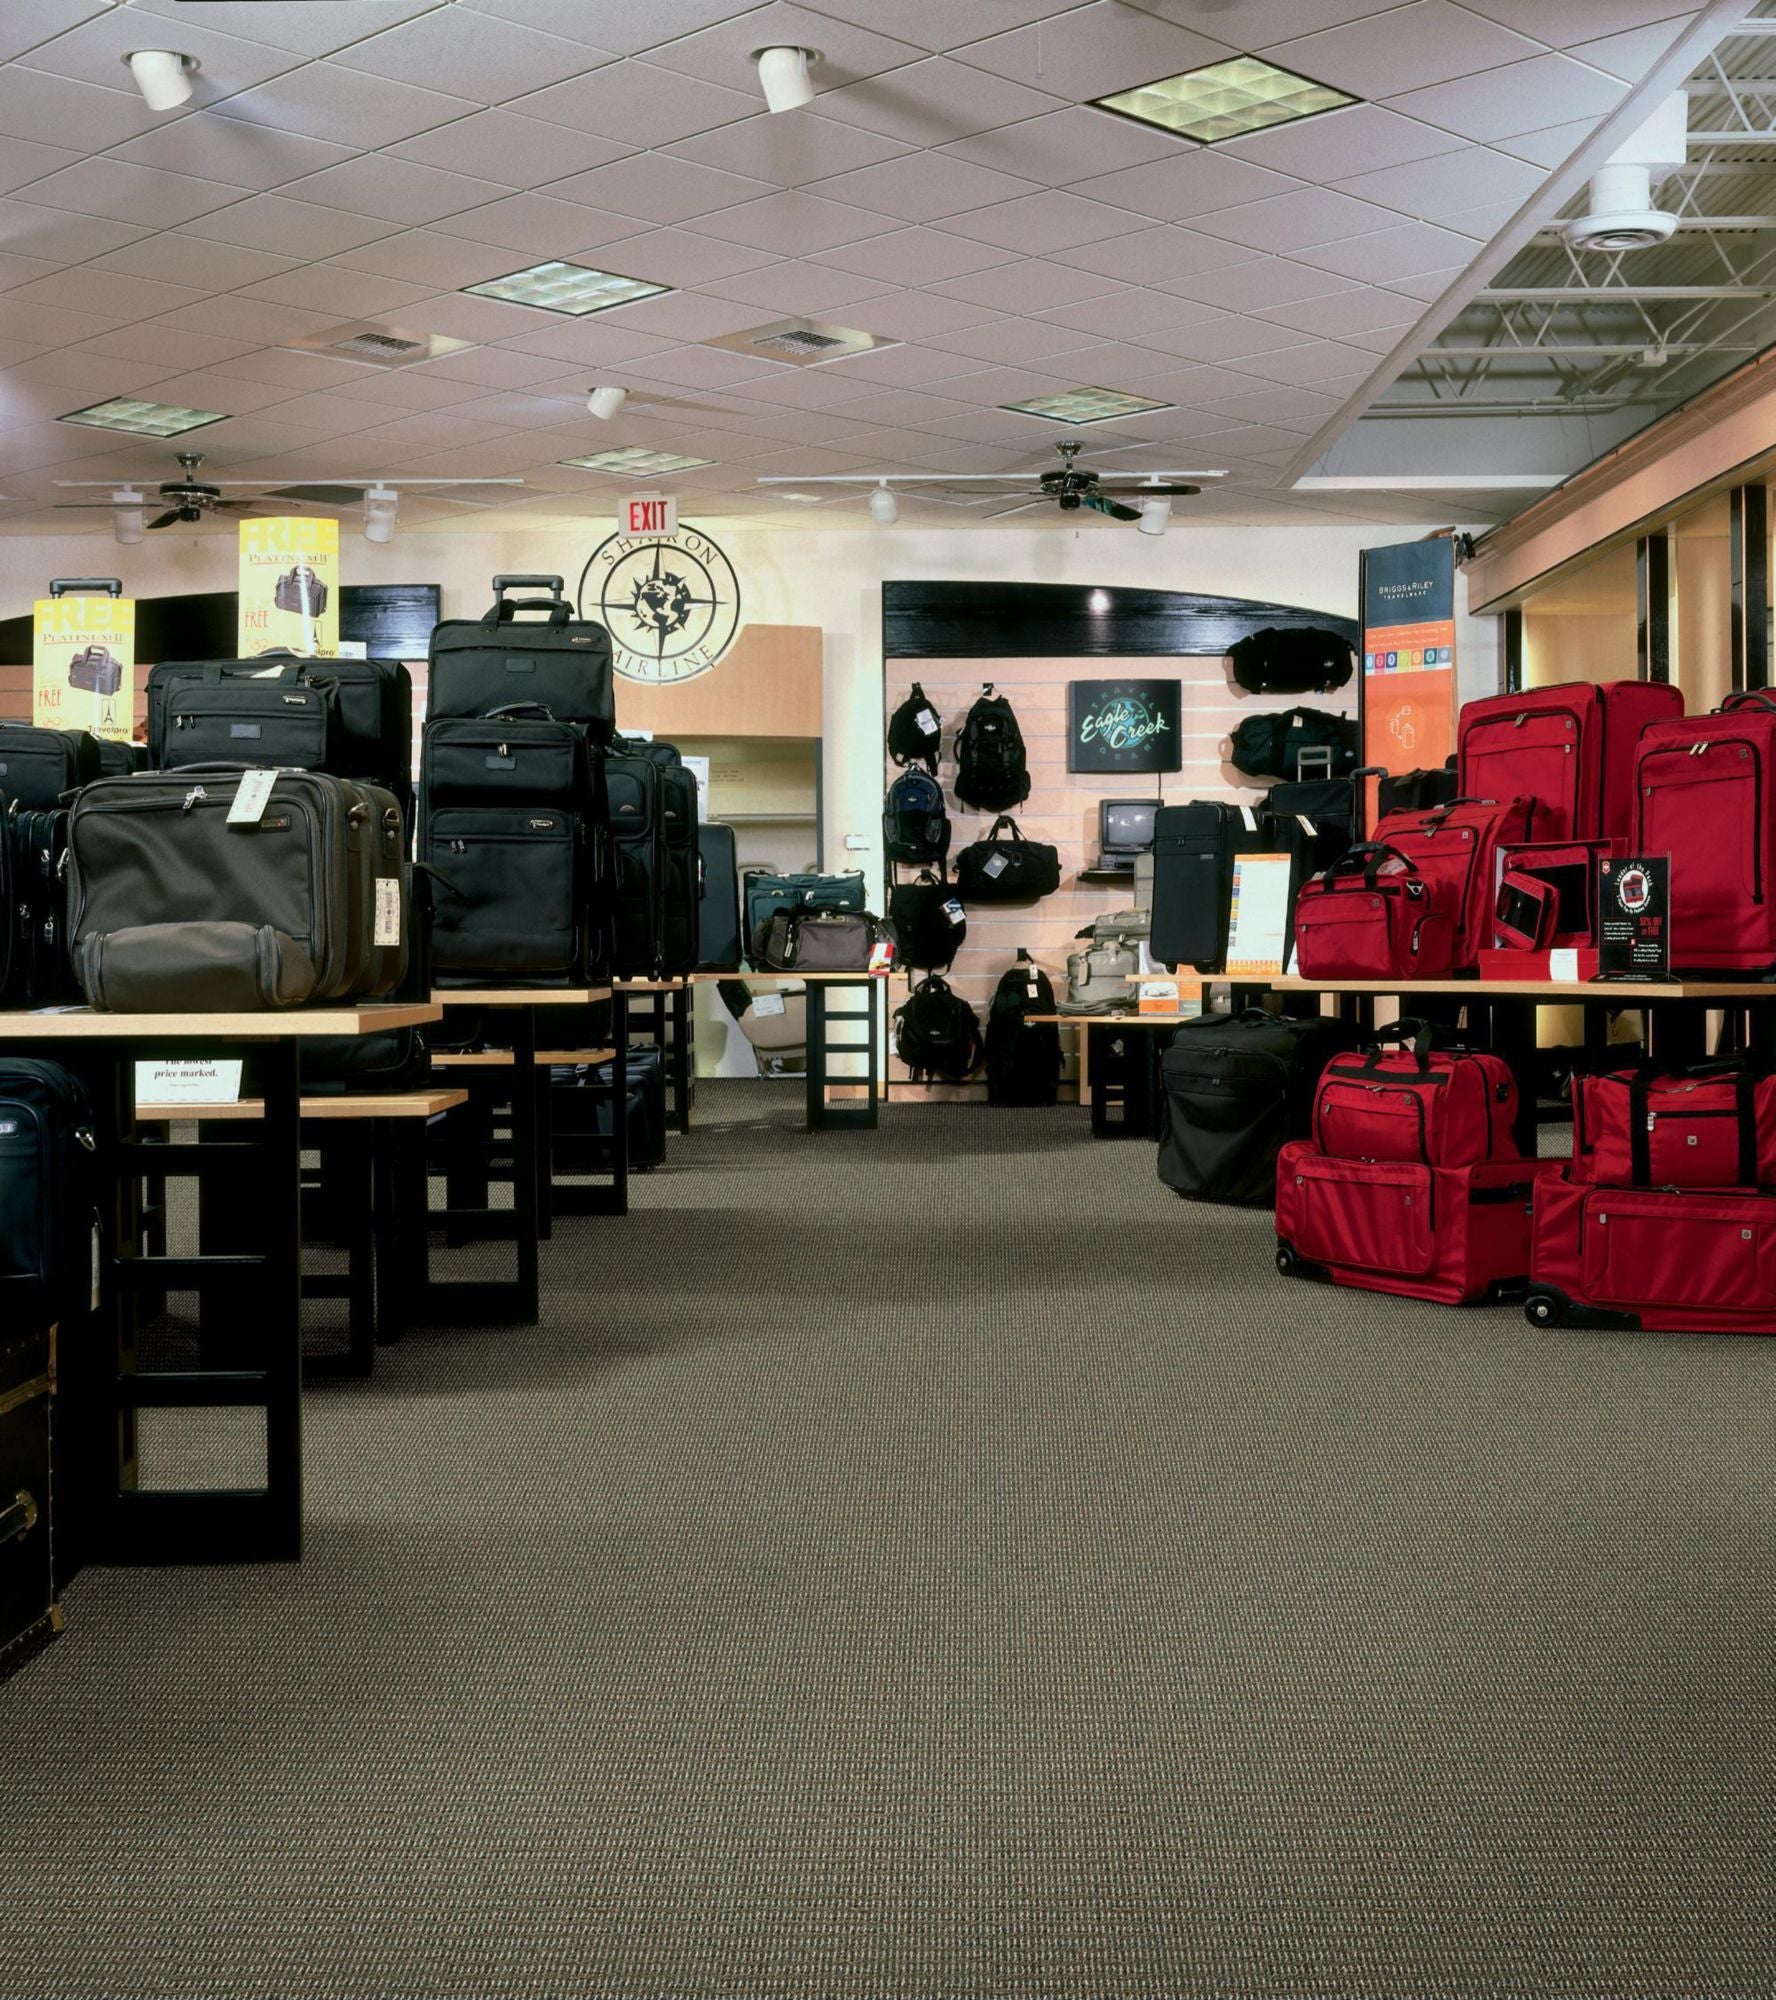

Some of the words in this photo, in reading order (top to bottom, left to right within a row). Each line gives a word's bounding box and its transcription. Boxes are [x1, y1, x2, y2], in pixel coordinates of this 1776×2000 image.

[630, 501, 668, 532] EXIT
[244, 610, 268, 629] FREE
[612, 645, 714, 678] AIRLINE
[38, 688, 62, 707] FREE
[1090, 687, 1155, 709] TRAVEL
[1080, 703, 1130, 743] Eagle
[1110, 711, 1171, 749] Creek
[154, 1069, 178, 1080] price
[180, 1068, 218, 1077] marked.
